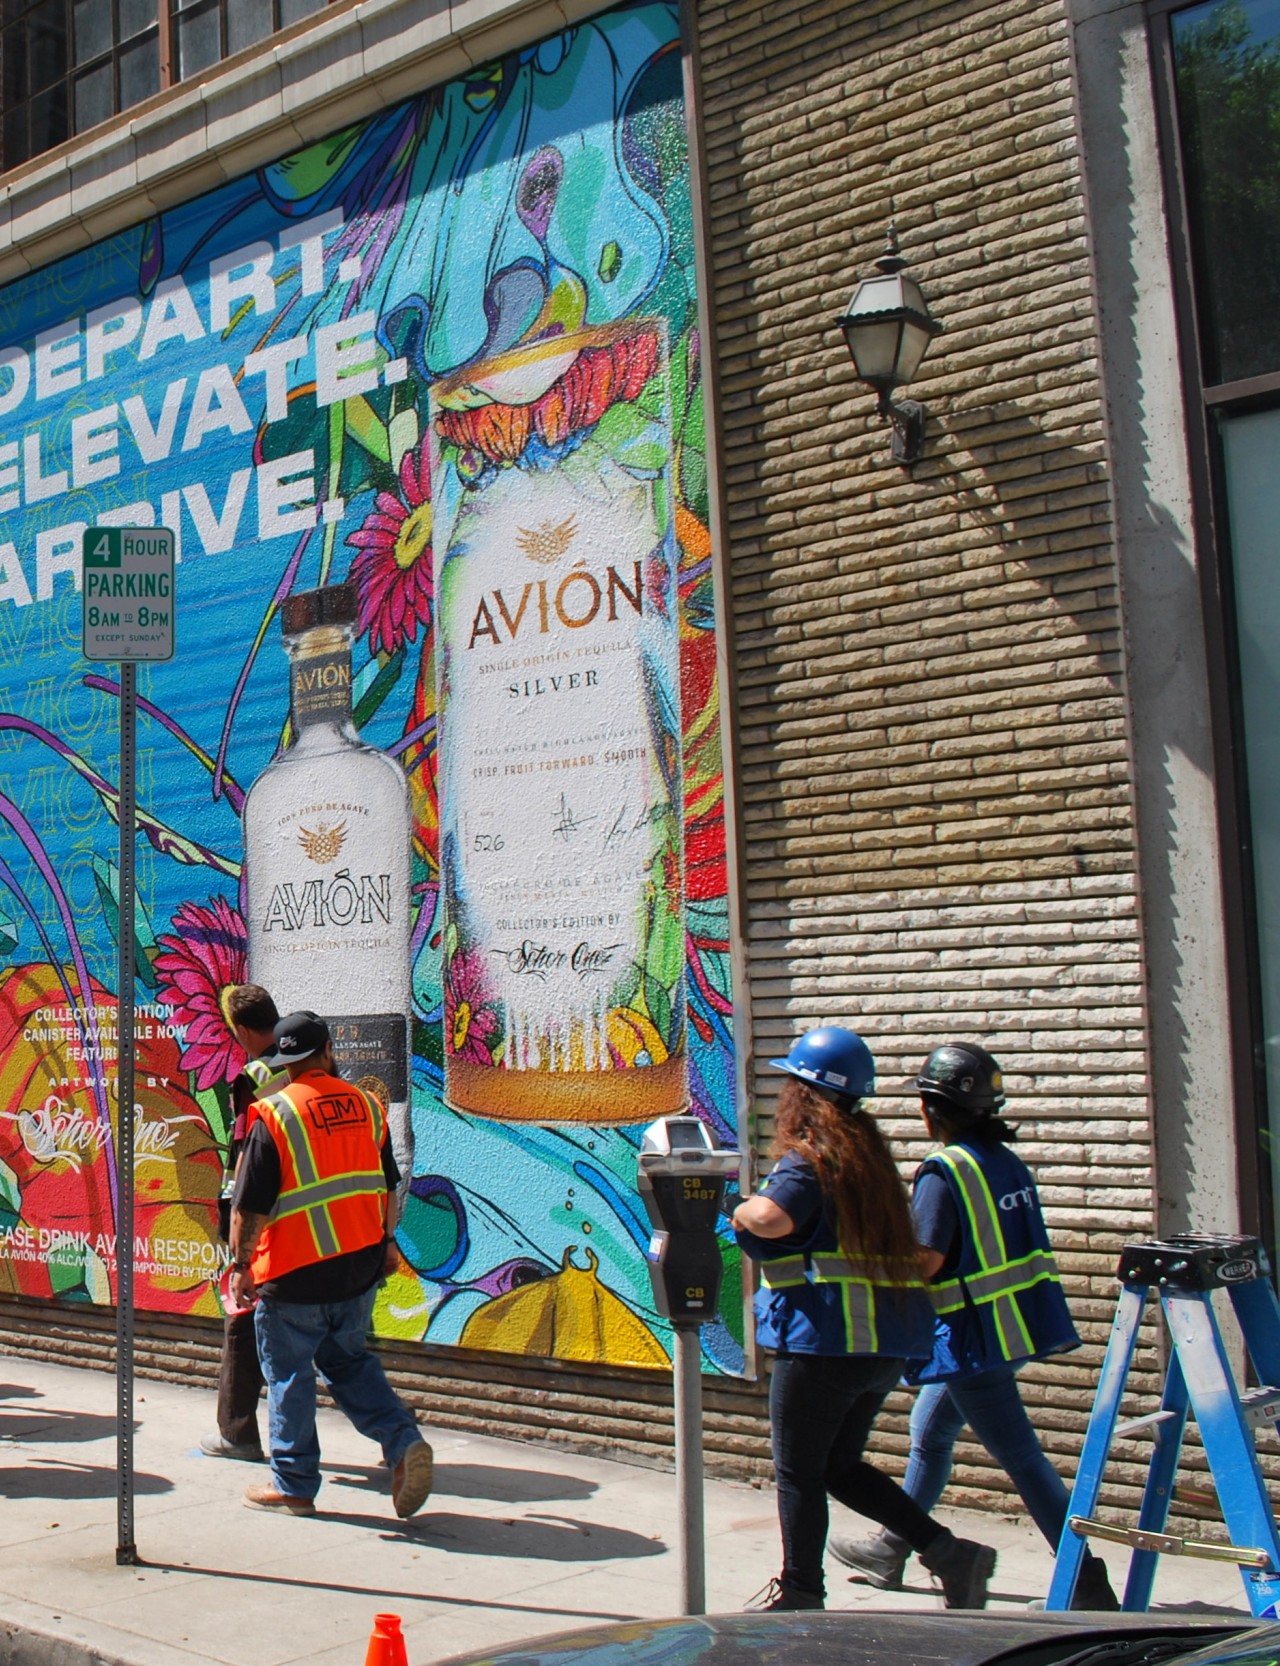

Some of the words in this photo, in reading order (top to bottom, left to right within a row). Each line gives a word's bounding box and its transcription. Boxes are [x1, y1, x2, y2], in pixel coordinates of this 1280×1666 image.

[92, 534, 111, 562] 4
[124, 539, 168, 556] HOUR
[88, 573, 169, 598] PARKING
[467, 559, 645, 650] AVIÓN
[88, 606, 120, 627] 8AM
[138, 606, 169, 627] 8PM
[95, 634, 126, 642] EXCEPT
[129, 634, 161, 642] SUNDAY
[508, 670, 599, 698] SILVER
[505, 761, 534, 775] FRUIT
[263, 868, 391, 932] AVIÓN
[35, 1005, 118, 1022] COLLECTOR'S
[23, 1027, 81, 1042] CANISTER
[156, 1023, 188, 1039] NOW
[147, 1077, 170, 1087] BY
[682, 1178, 702, 1188] CB
[683, 1189, 717, 1200] 3487
[39, 1227, 91, 1252] DRINK
[94, 1233, 149, 1259] AVN
[154, 1237, 230, 1267] RESPON
[10, 1247, 36, 1262] AVIÓN
[132, 1261, 181, 1277] IMPORTED
[183, 1265, 195, 1278] BY
[197, 1267, 223, 1281] TEQU
[685, 1287, 705, 1298] CB
